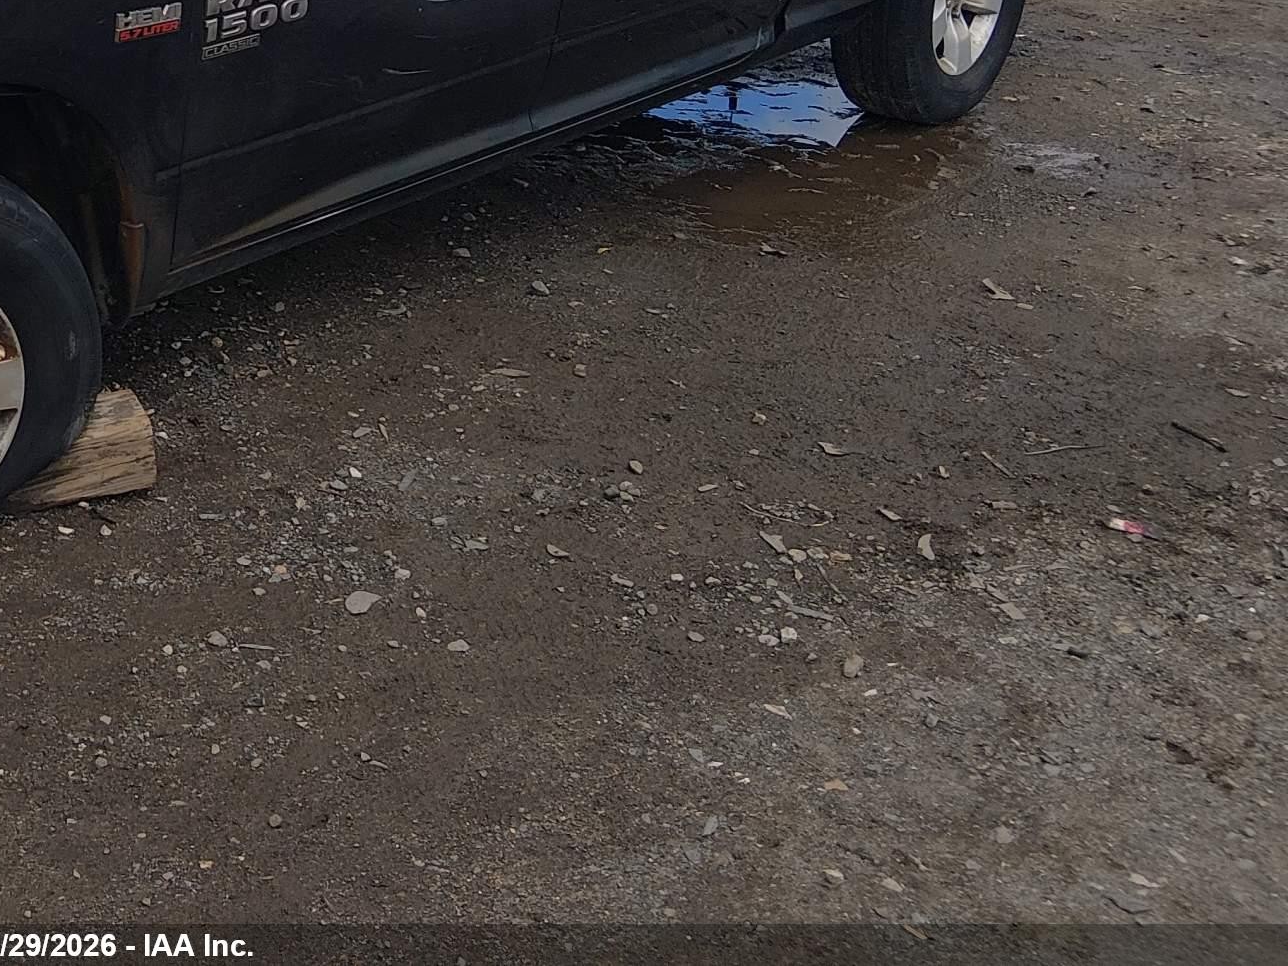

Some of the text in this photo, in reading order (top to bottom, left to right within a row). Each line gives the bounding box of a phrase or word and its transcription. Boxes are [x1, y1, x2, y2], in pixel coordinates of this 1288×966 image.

[116, 2, 182, 29] HEMI
[143, 20, 179, 37] LITER
[204, 35, 260, 58] CLASSIC
